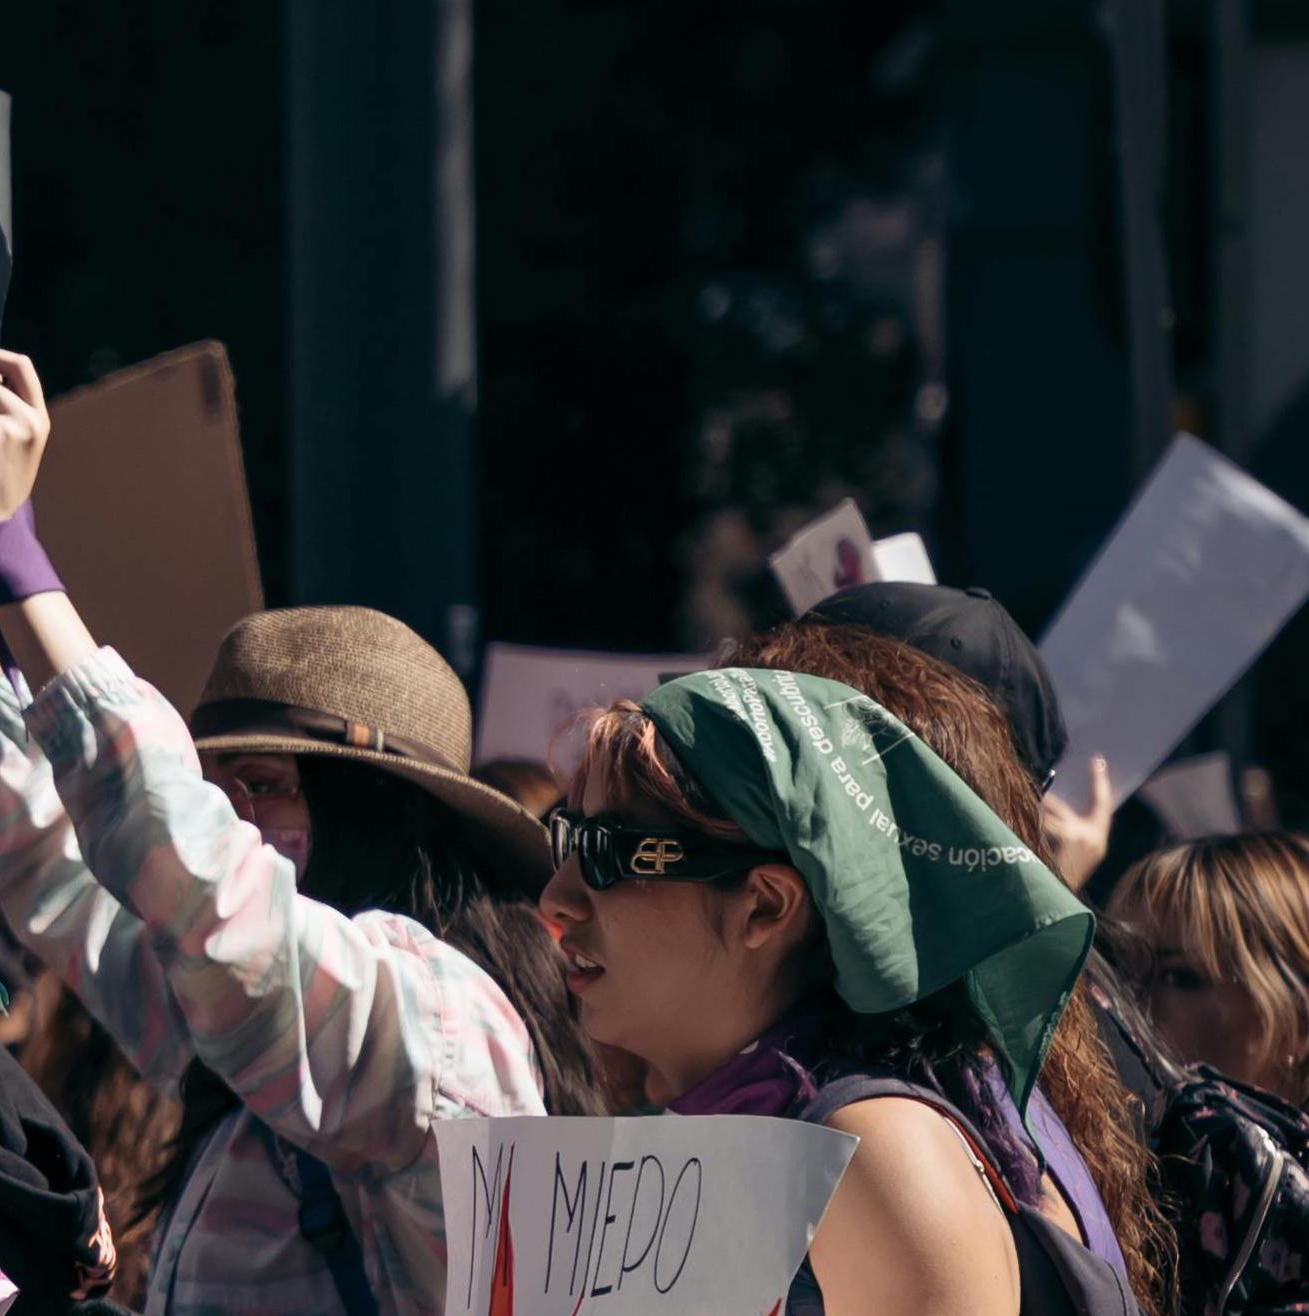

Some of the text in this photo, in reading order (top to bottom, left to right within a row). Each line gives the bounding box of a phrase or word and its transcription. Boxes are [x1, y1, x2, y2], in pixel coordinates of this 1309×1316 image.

[831, 757, 874, 811] para
[869, 809, 943, 861] sexual
[466, 1141, 703, 1310] MI MIEDO
